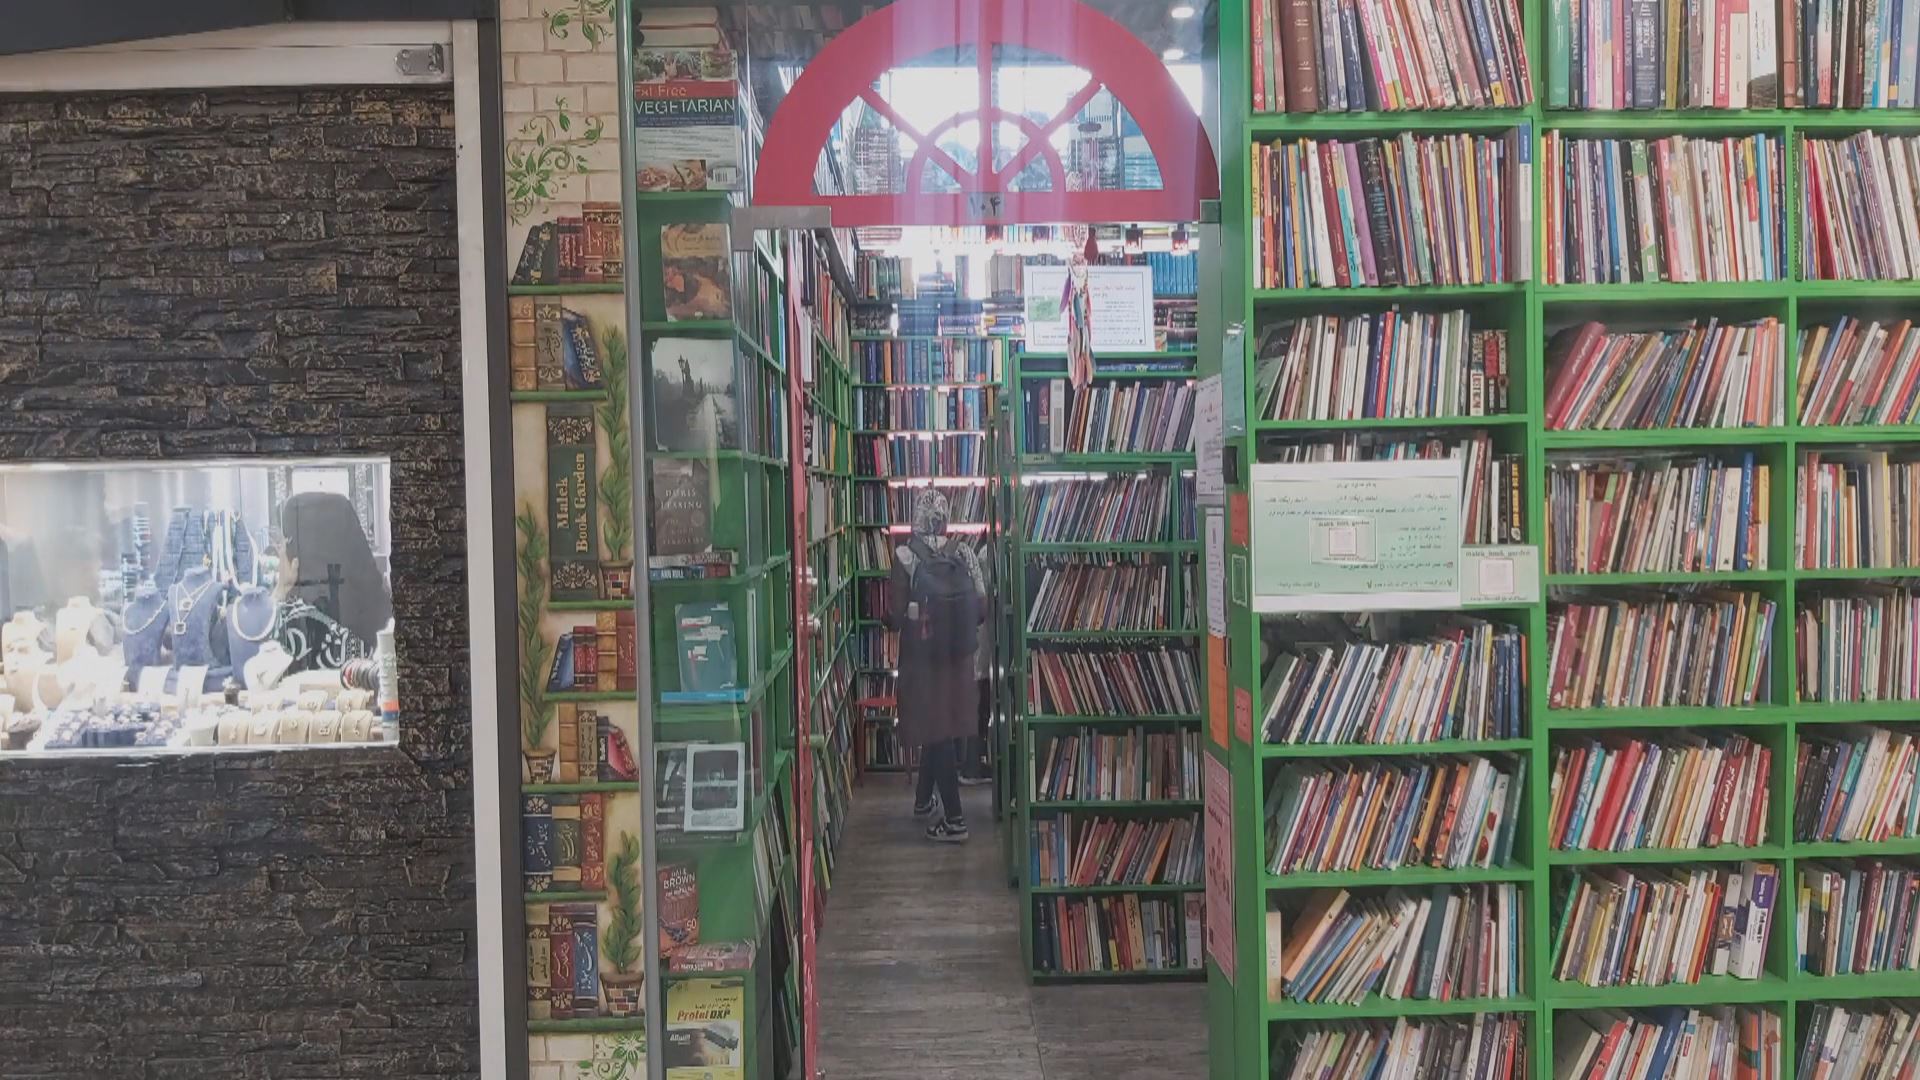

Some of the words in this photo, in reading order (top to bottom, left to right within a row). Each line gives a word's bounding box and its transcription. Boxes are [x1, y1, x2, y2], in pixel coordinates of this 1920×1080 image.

[658, 85, 687, 97] Free
[635, 98, 735, 115] VEGETARIAN
[573, 452, 587, 509] Garden
[556, 477, 569, 530] Malek
[574, 513, 588, 553] Book
[663, 874, 696, 889] BROWN
[710, 1008, 731, 1019] DXP
